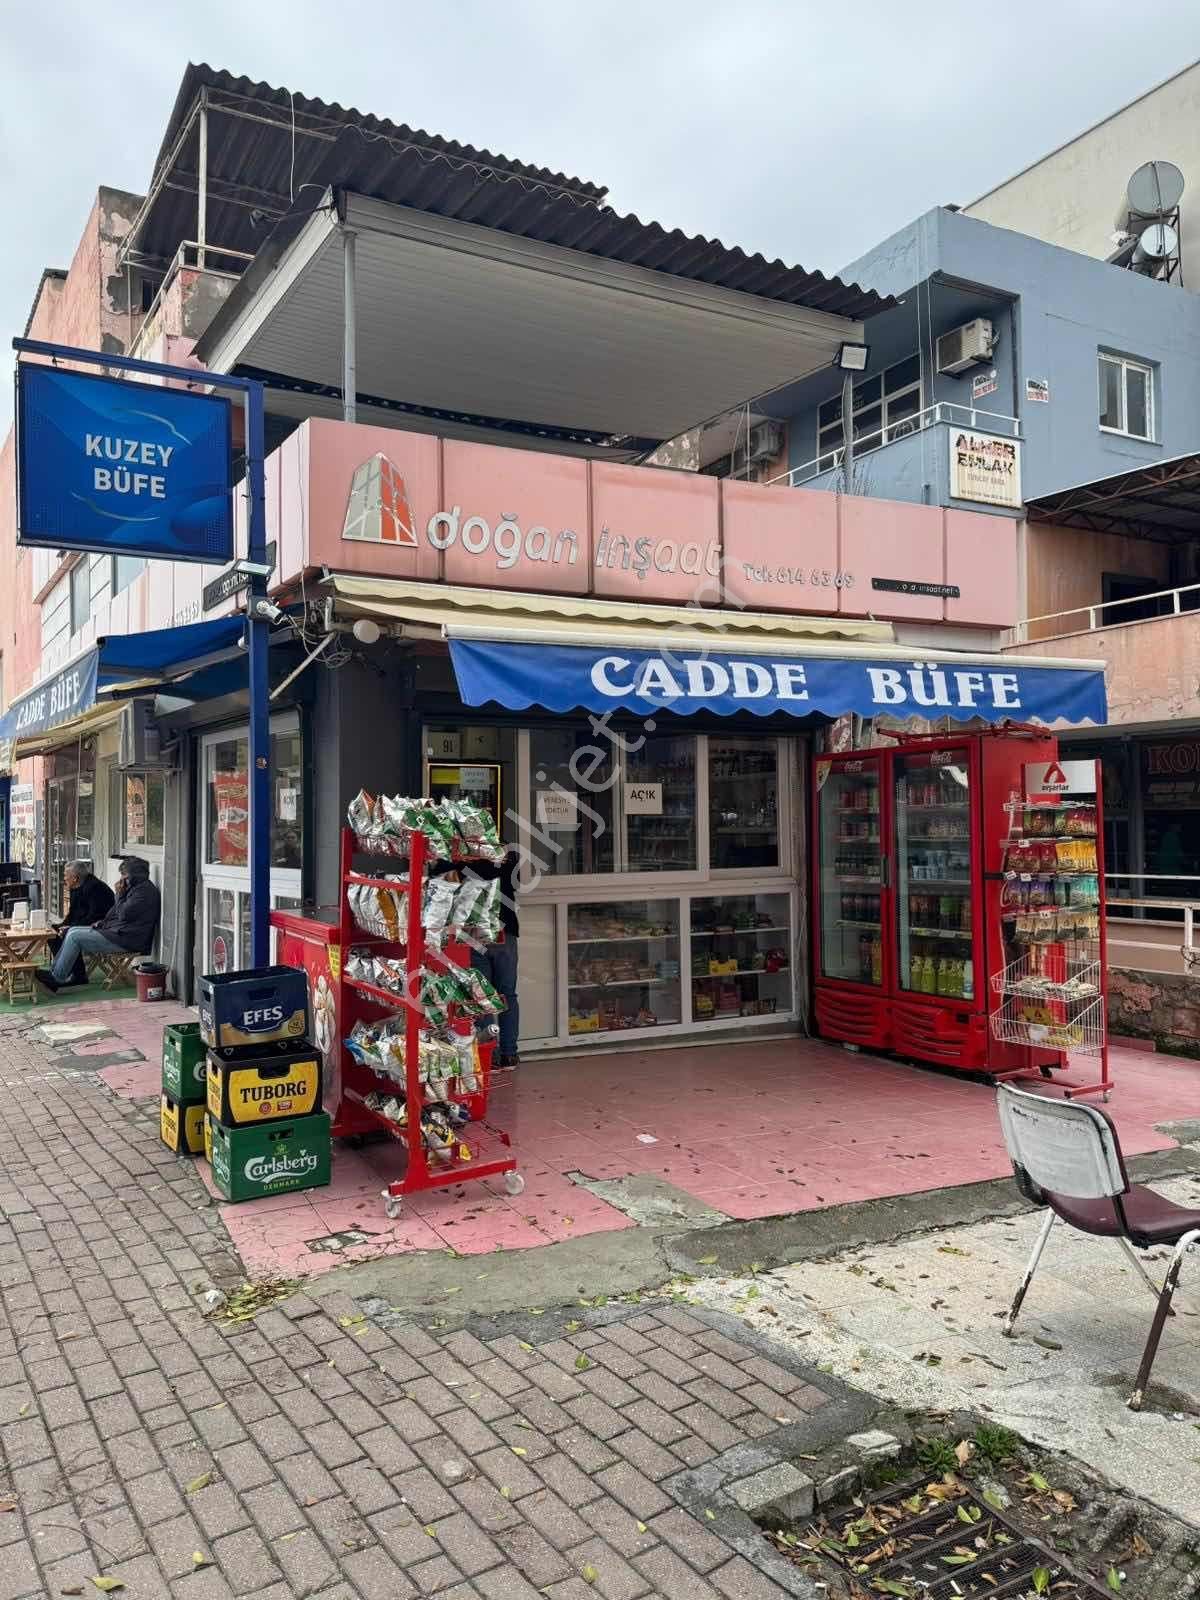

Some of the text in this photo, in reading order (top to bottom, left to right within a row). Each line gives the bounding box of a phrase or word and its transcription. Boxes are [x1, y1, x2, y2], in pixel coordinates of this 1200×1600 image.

[86, 433, 174, 467] KUZEY
[94, 466, 166, 498] BÜFE
[427, 506, 722, 580] doğan inşaat
[590, 656, 1021, 708] CADDE BÜFE
[16, 671, 80, 731] CADDE BÜFE
[630, 789, 656, 802] AÇIK
[243, 1005, 283, 1026] EFES
[240, 1081, 307, 1103] TUBORG
[244, 1149, 318, 1183] Carlsberg
